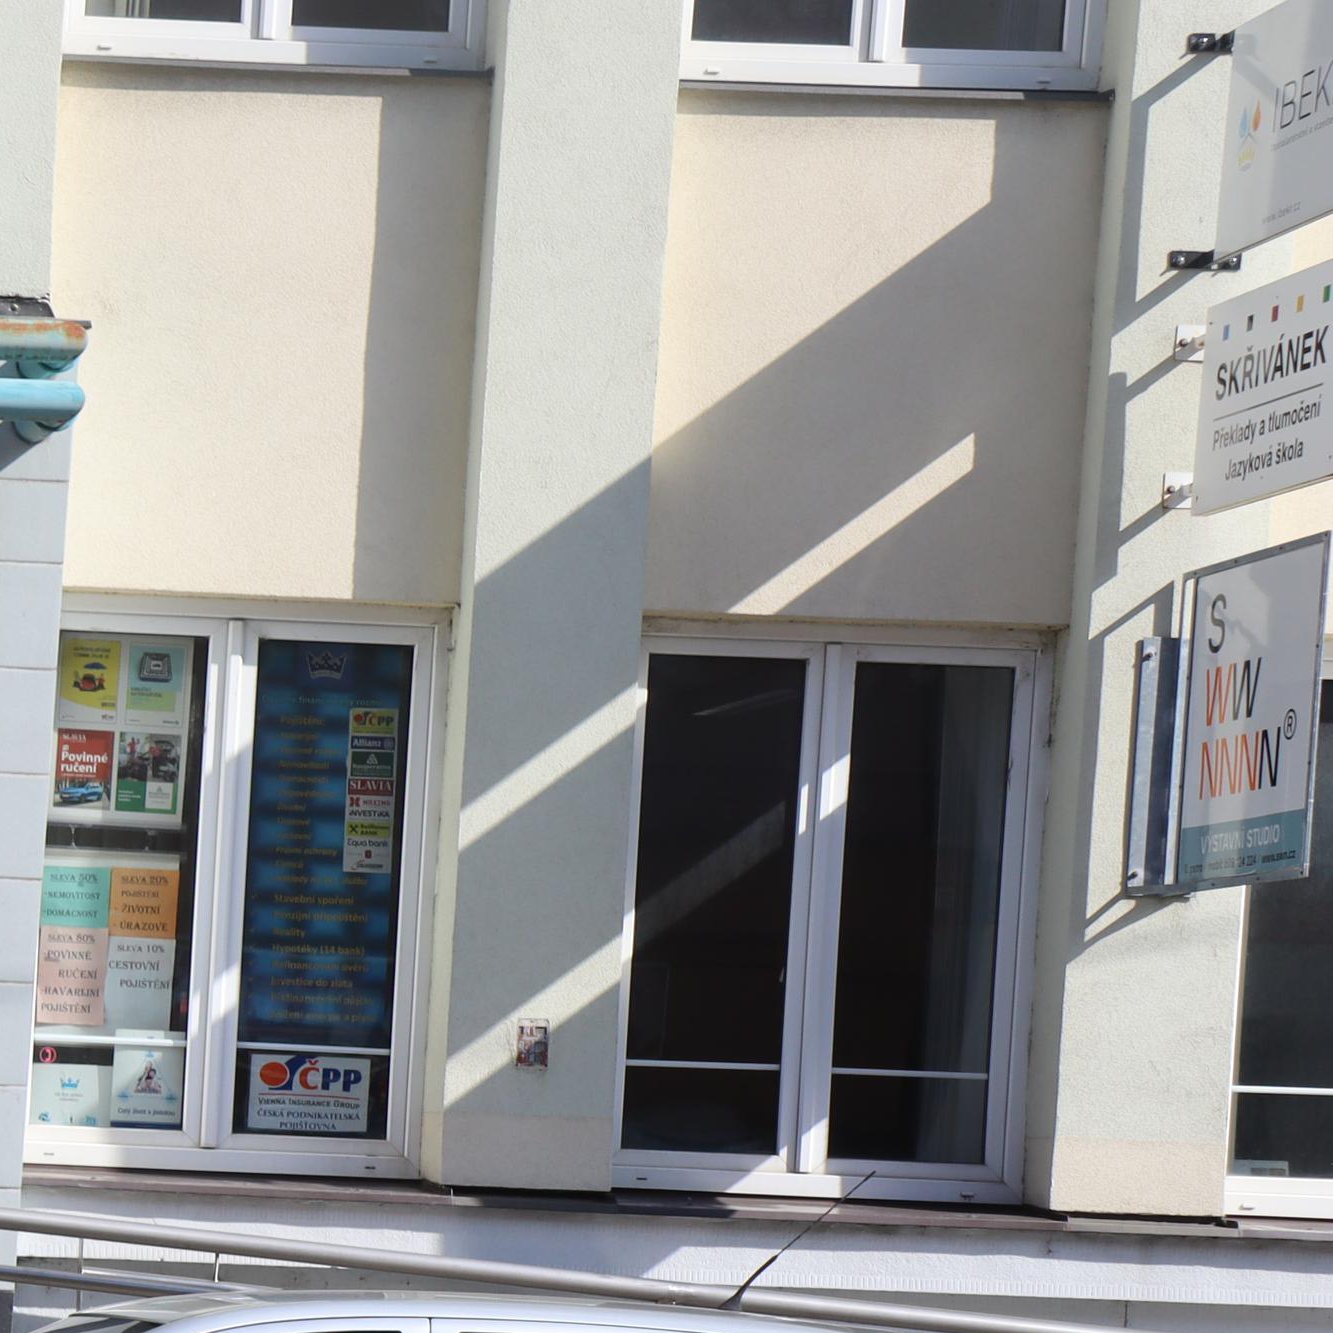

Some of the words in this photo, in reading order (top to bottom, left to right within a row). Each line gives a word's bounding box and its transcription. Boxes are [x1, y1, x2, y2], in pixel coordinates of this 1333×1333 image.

[1272, 58, 1333, 133] IBEK
[1215, 325, 1329, 401] SKŘIVÁNEK
[1212, 421, 1257, 451] Překlady
[1258, 420, 1266, 436] a
[1267, 394, 1322, 430] tlumočení
[1224, 444, 1273, 481] Jazyková
[1275, 438, 1304, 464] škola
[1208, 593, 1227, 654] S
[60, 761, 97, 774] ručení
[61, 750, 109, 764] Povinné
[349, 779, 392, 791] SLAVIA
[1200, 830, 1244, 855] VÝSTAVNÍ
[1246, 823, 1281, 848] STUDIO
[58, 967, 98, 980] RUČENÍ
[108, 960, 160, 971] CESTOVNÍ
[119, 978, 170, 990] POJIŠTĚNÍ
[298, 1058, 363, 1092] ČPP
[286, 1109, 361, 1121] PODNIKATELSKÁ
